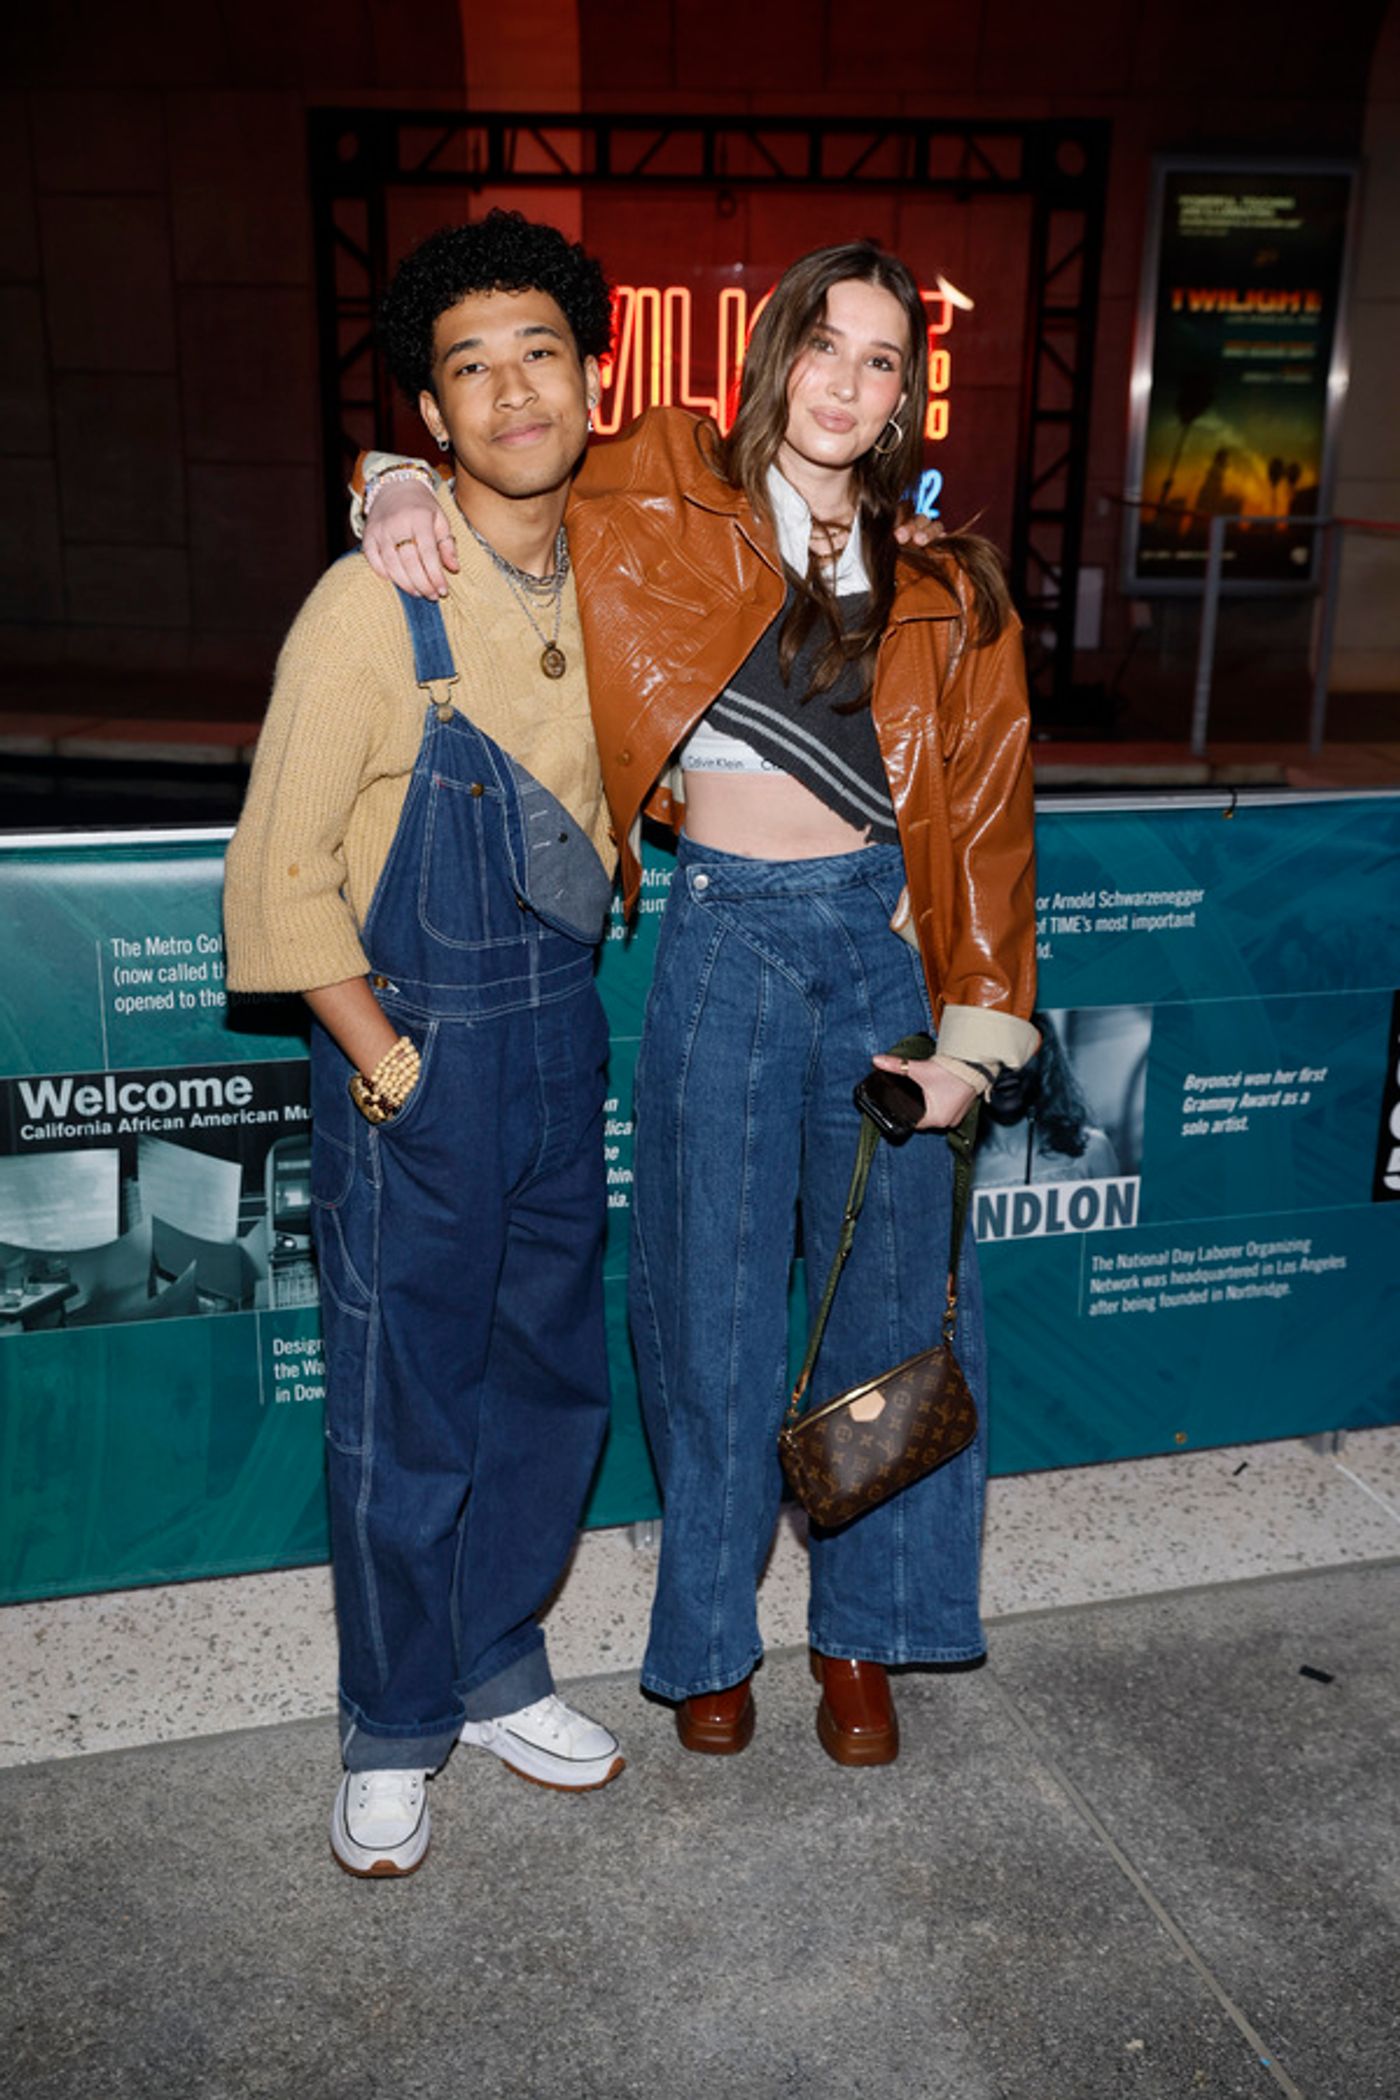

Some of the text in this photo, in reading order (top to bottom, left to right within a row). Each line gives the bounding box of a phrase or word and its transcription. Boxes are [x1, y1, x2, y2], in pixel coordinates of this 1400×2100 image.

[1052, 891, 1096, 910] Arnold
[1099, 889, 1205, 909] Schwarzenegger
[1050, 915, 1093, 934] TIME's
[1095, 914, 1129, 932] most
[1131, 911, 1196, 932] important
[110, 938, 141, 958] The
[145, 936, 192, 956] Metro
[113, 966, 153, 988] (now
[158, 962, 208, 982] called
[114, 988, 227, 1015] opened to the
[1273, 1068, 1298, 1084] her
[1298, 1067, 1328, 1083] first
[18, 1074, 253, 1120] Welcome
[1182, 1091, 1311, 1114] Grammy Award as a
[20, 1122, 112, 1141] California
[118, 1116, 184, 1134] African
[190, 1109, 279, 1128] American
[1181, 1119, 1210, 1136] solo
[977, 1182, 1135, 1239] NDLON
[1091, 1238, 1312, 1272] The National Day Laborer Organizing
[1090, 1255, 1347, 1294] Network was headquartered in Los Angeles
[1089, 1299, 1119, 1316] after
[1121, 1294, 1156, 1313] being
[1159, 1288, 1209, 1308] founded
[1211, 1286, 1224, 1301] in
[274, 1362, 300, 1380] the
[275, 1386, 291, 1403] in
